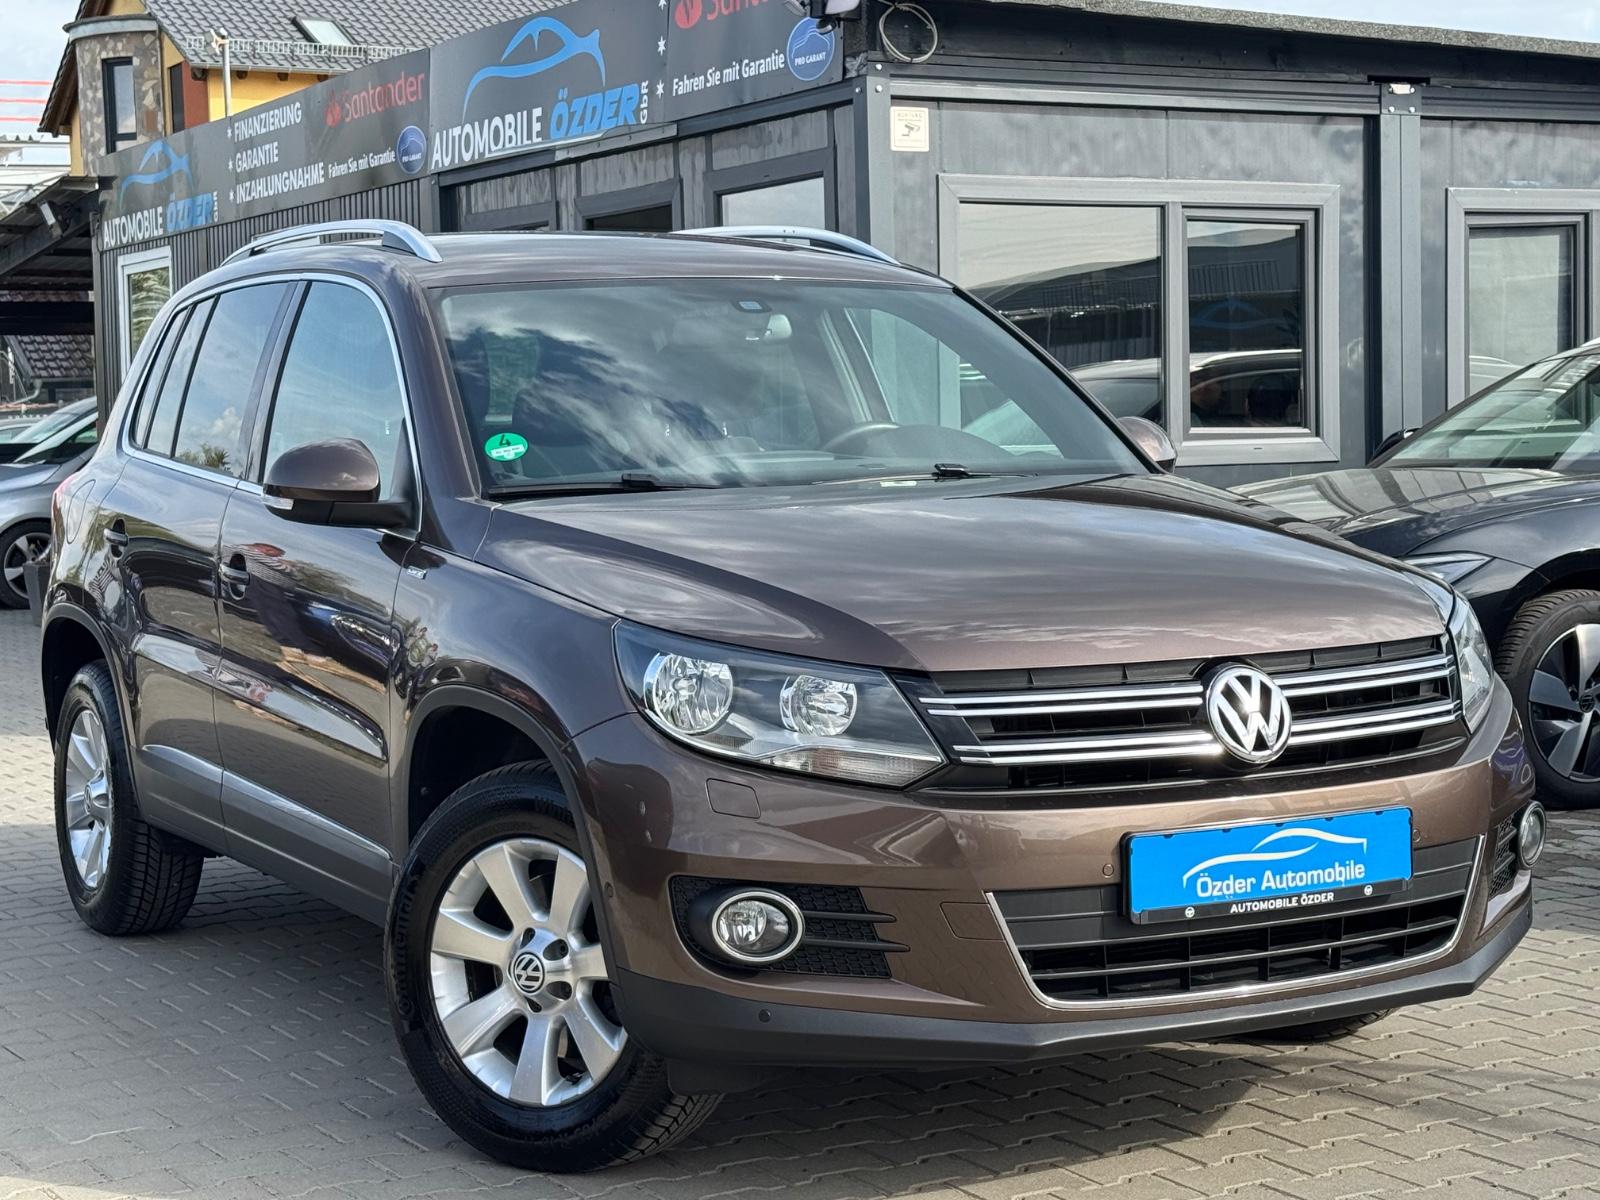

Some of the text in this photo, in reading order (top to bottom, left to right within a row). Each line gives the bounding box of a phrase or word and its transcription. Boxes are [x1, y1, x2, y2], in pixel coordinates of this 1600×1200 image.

[672, 49, 785, 97] Fahren Sie mit Garantie
[343, 71, 425, 123] Santander
[234, 101, 302, 142] FINANZIERUNG
[431, 80, 649, 169] AUTOMOBILE ÖZDER GbR
[235, 141, 279, 173] GARANTIE
[328, 162, 348, 178] Fahren
[348, 157, 358, 173] Sie
[358, 154, 369, 170] mit
[369, 147, 396, 167] Garantie
[236, 162, 325, 204] INZAHLUNGNAHME
[103, 206, 164, 249] AUTOMOBILE
[166, 192, 214, 235] ÖZDER
[1196, 859, 1366, 898] Özder Automobile
[1230, 892, 1335, 914] AUTOMOBILE ÖZDER
